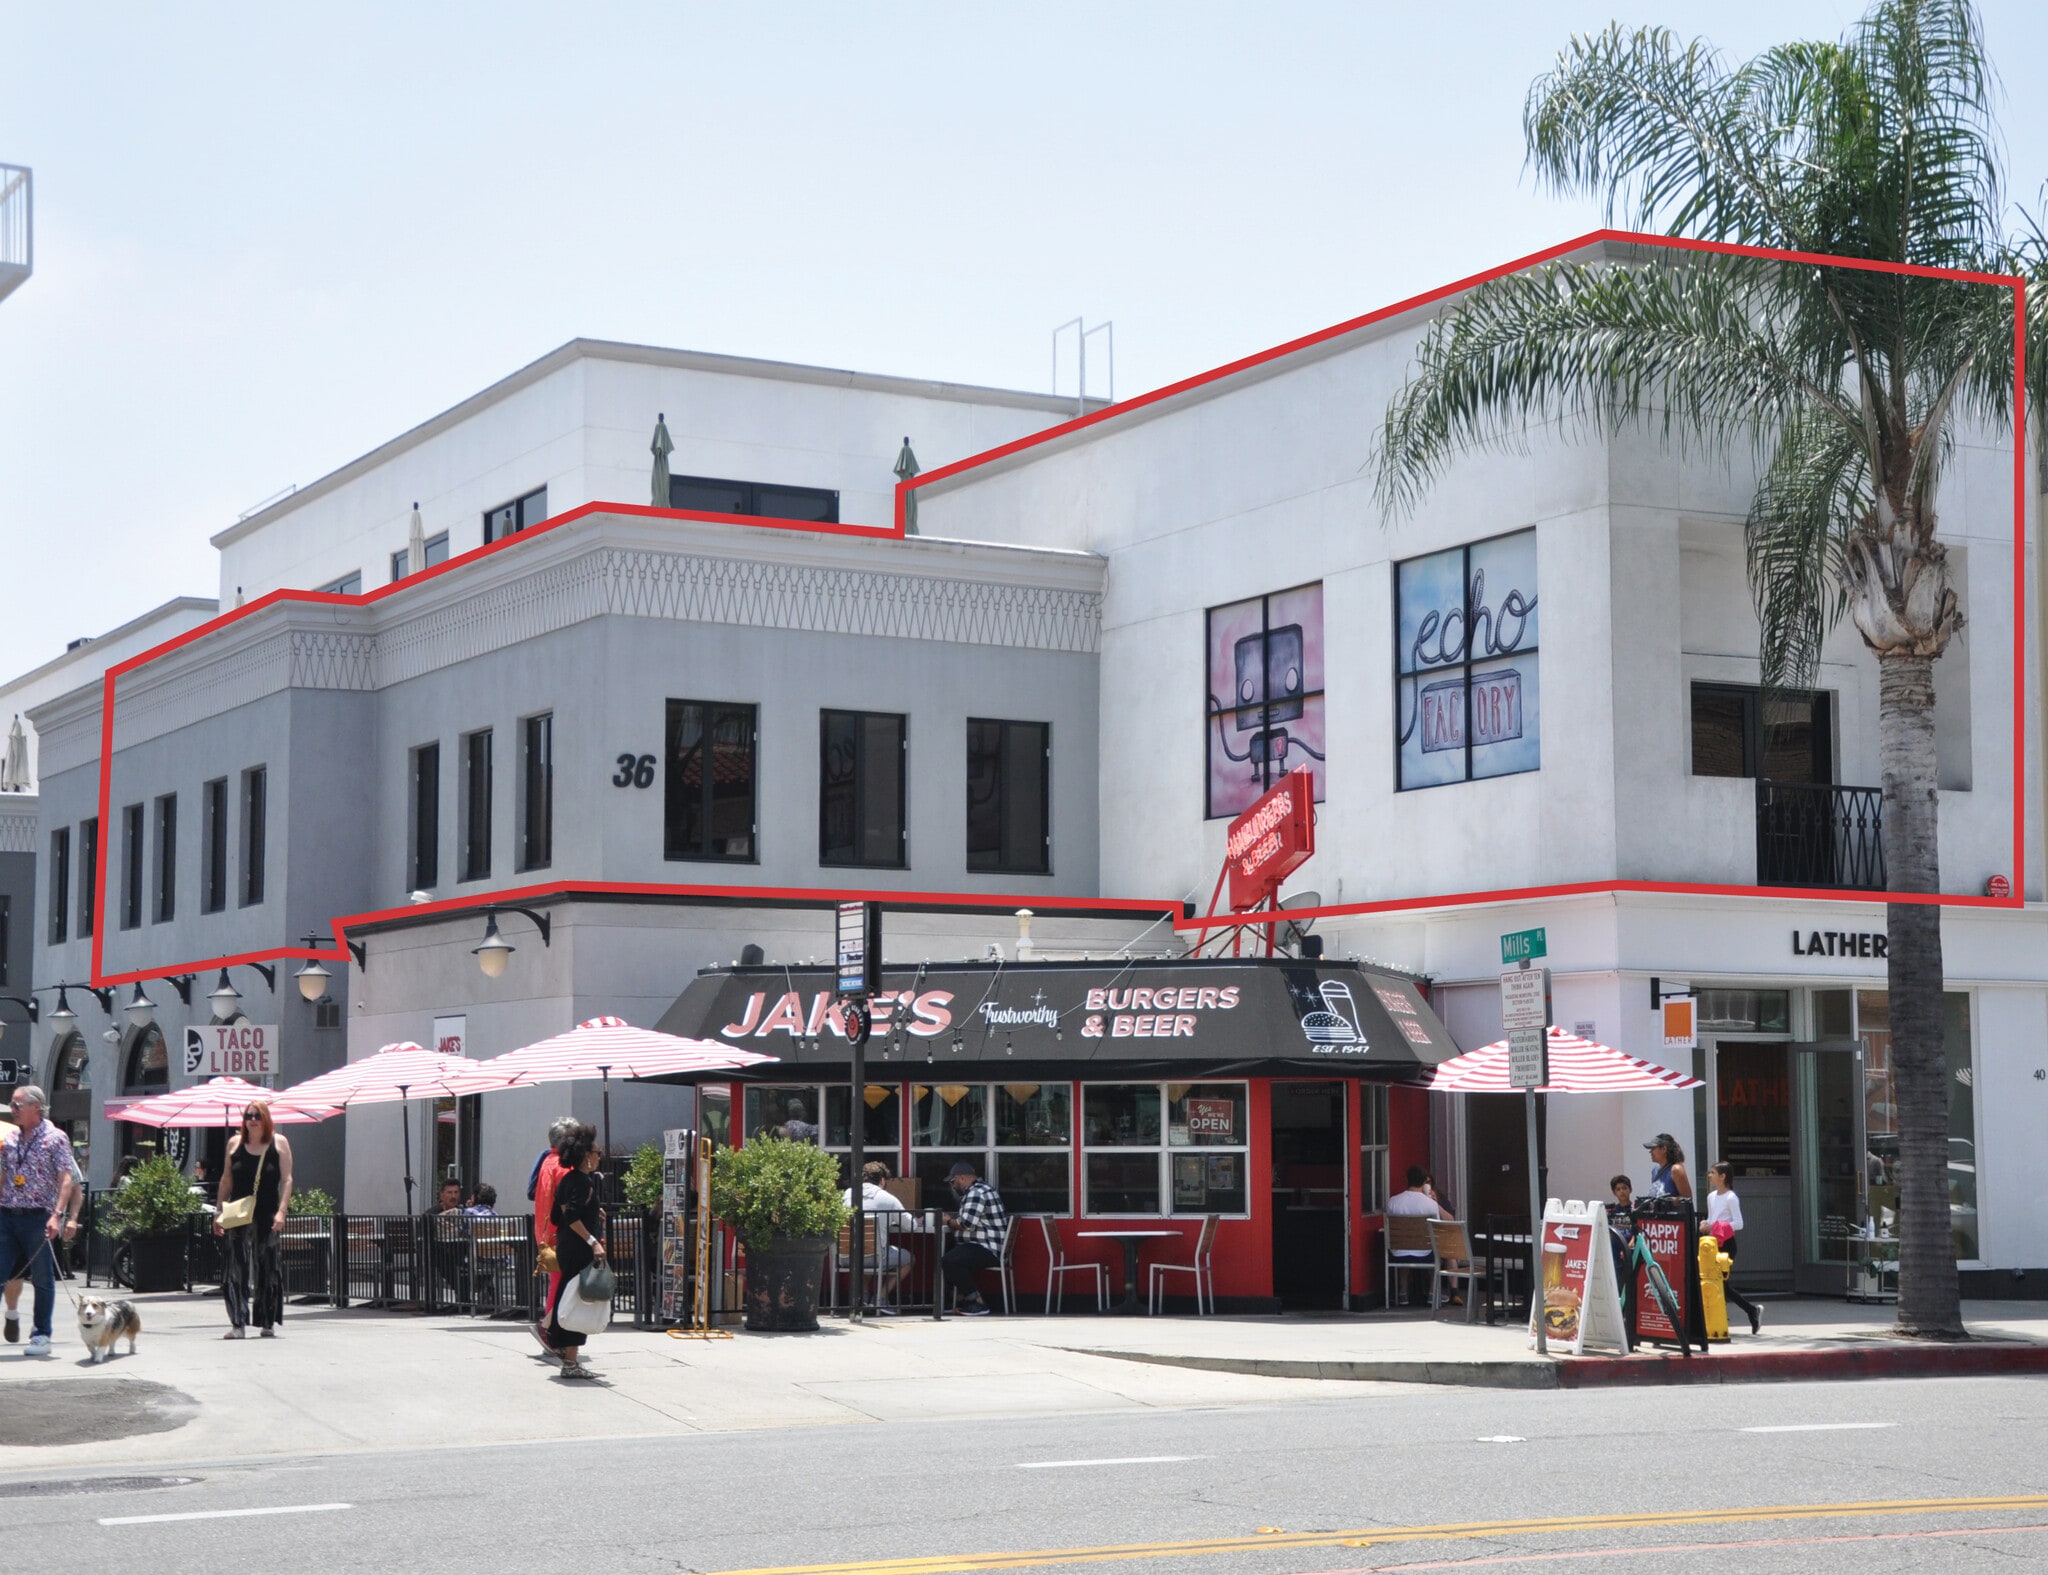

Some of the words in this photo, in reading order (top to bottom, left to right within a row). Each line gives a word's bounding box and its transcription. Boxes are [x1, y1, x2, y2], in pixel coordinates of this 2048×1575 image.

[1414, 568, 1538, 665] echo
[1424, 686, 1517, 747] FACORY
[612, 753, 657, 789] 36
[1503, 934, 1530, 957] Mills
[1793, 930, 1888, 958] LATHER
[720, 990, 955, 1038] JAKE'S
[979, 1002, 1057, 1028] Trustworthy
[1085, 986, 1240, 1010] BURGERS
[1081, 1014, 1104, 1037] &
[1112, 1014, 1197, 1037] BEER
[217, 1028, 265, 1050] TACO
[1313, 1045, 1339, 1054] EST.
[1342, 1046, 1369, 1054] 1947
[1664, 1035, 1693, 1045] LATHER
[210, 1050, 270, 1073] LIBRE
[2033, 1069, 2046, 1080] 40
[1197, 1104, 1212, 1115] Yes
[1190, 1118, 1229, 1130] OPEN
[1641, 1223, 1679, 1240] HAPPY
[1565, 1259, 1587, 1270] JAKE'S
